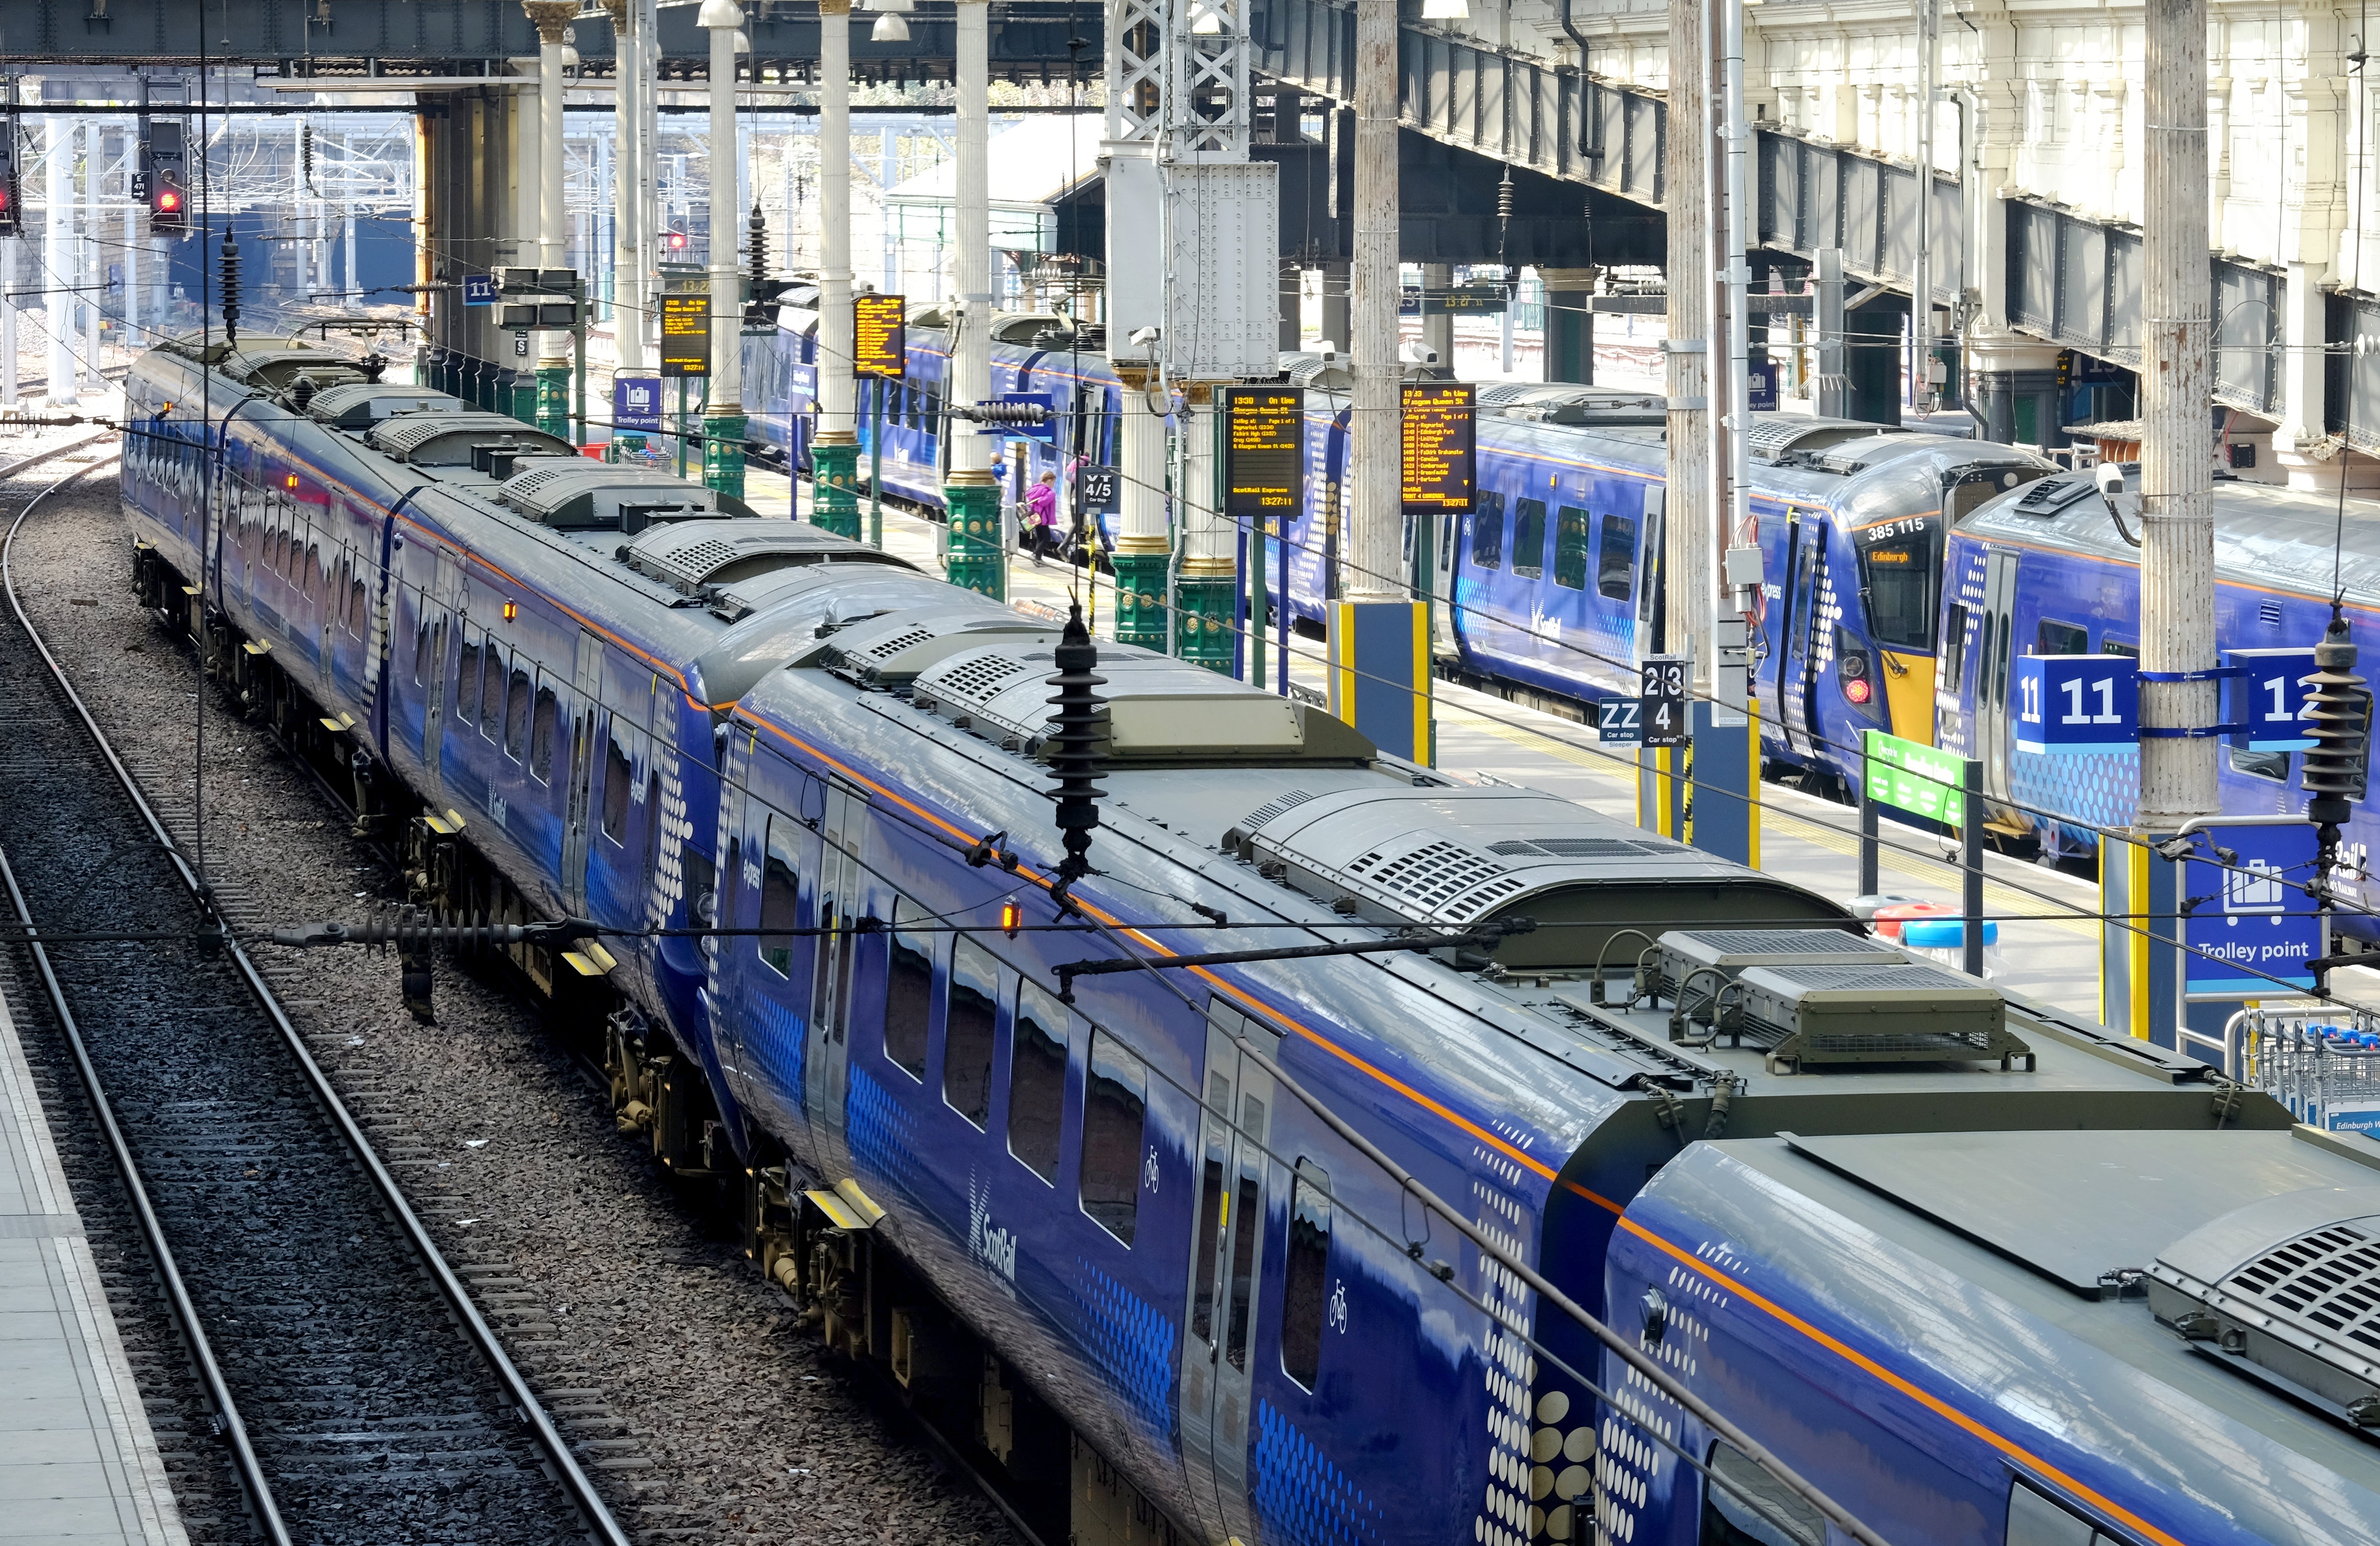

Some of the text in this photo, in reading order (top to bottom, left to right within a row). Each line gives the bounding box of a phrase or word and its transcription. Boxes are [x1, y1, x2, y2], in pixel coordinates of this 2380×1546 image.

[471, 281, 491, 296] 11
[518, 341, 525, 351] S
[617, 417, 639, 425] Trolley
[1085, 483, 1111, 496] 4/5
[1261, 497, 1292, 505] 13:27:11
[1868, 517, 1924, 541] 385 115
[1873, 552, 1908, 563] Edinburgh
[1645, 665, 1682, 698] 2/3
[2021, 675, 2040, 723] 11
[2061, 677, 2121, 724] 11
[2264, 676, 2323, 721] 12
[1601, 703, 1640, 728] ZZ
[1656, 703, 1670, 730] 4
[2330, 841, 2358, 880] Rail
[2338, 881, 2357, 898] RAILWAY
[2198, 941, 2309, 962] Trolley point
[2336, 1121, 2373, 1130] Edinburgh
[983, 1213, 1017, 1282] ScotRail
